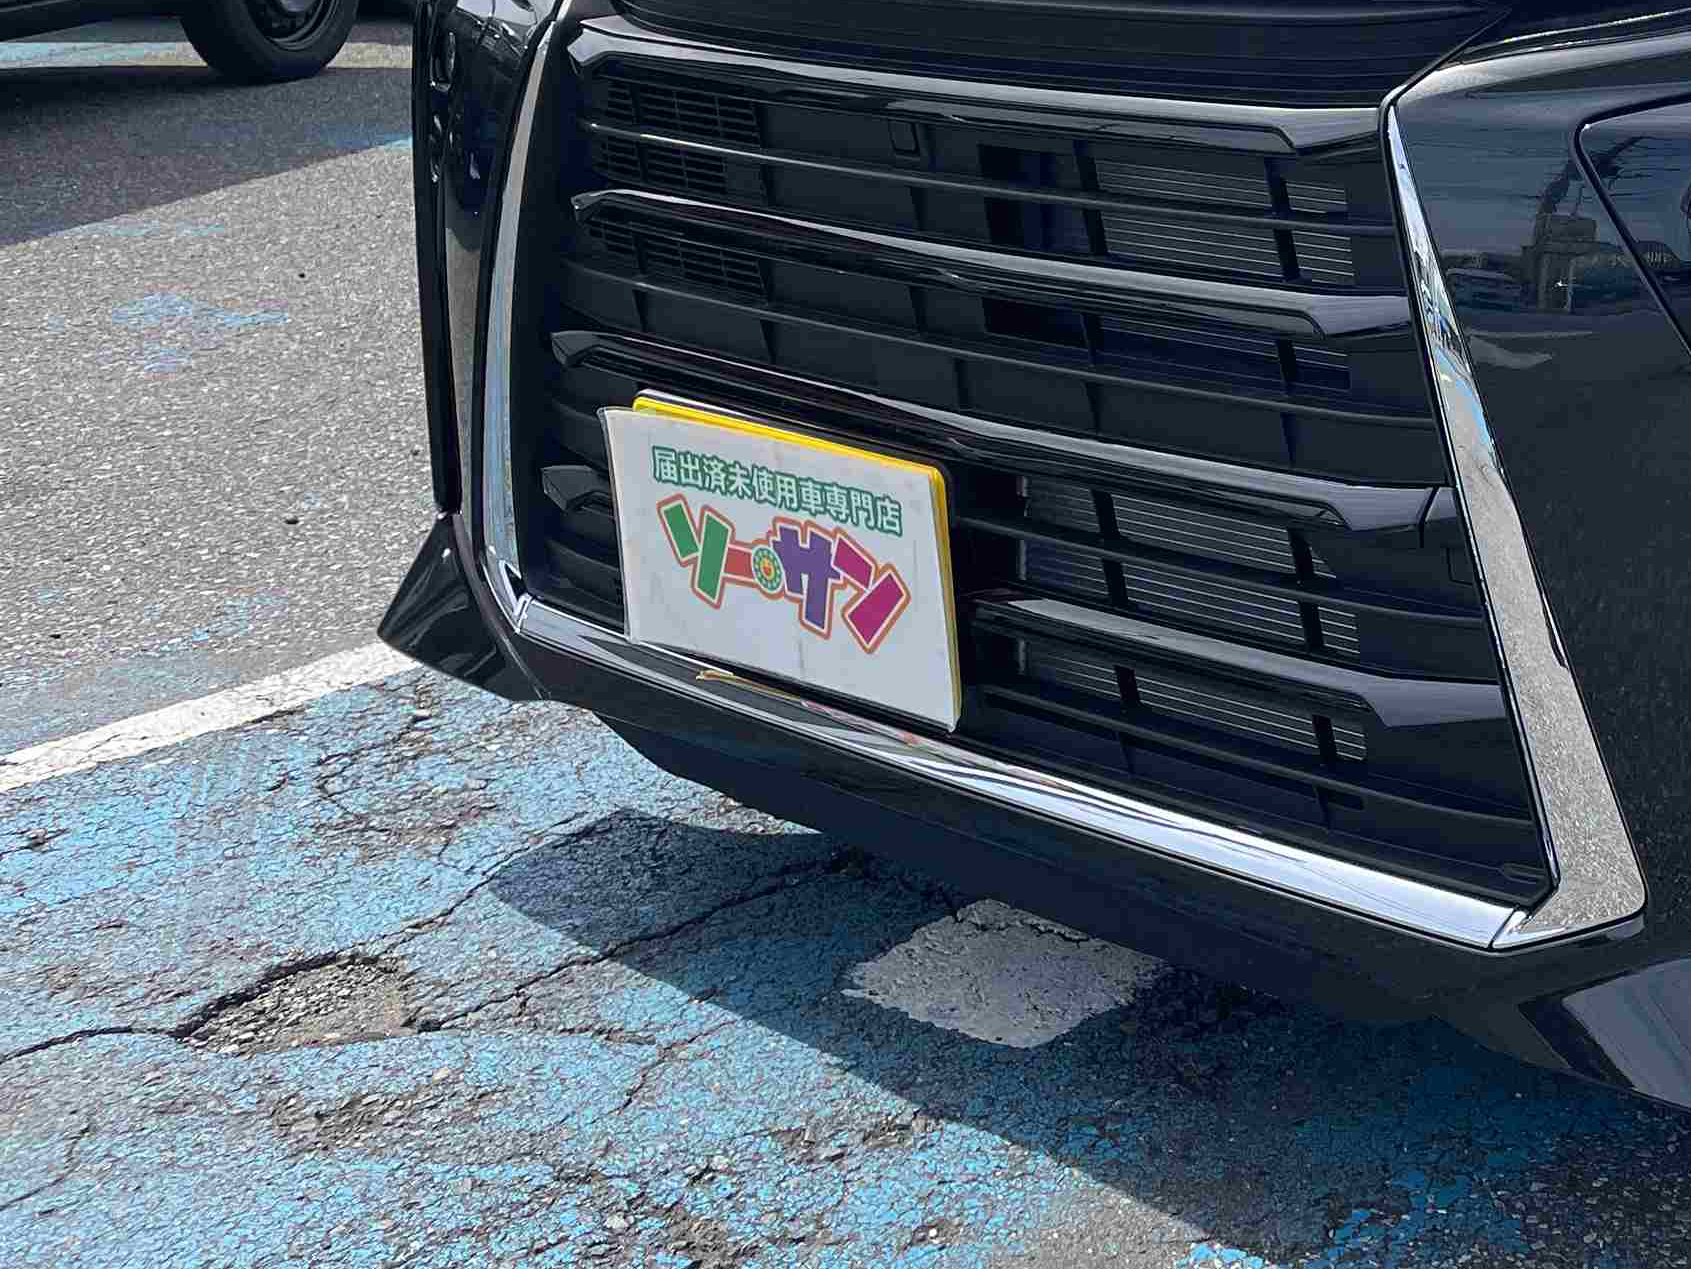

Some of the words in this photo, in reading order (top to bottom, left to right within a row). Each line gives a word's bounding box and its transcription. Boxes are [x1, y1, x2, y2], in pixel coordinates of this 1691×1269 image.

[652, 446, 903, 537] 届出済未使用車専門店
